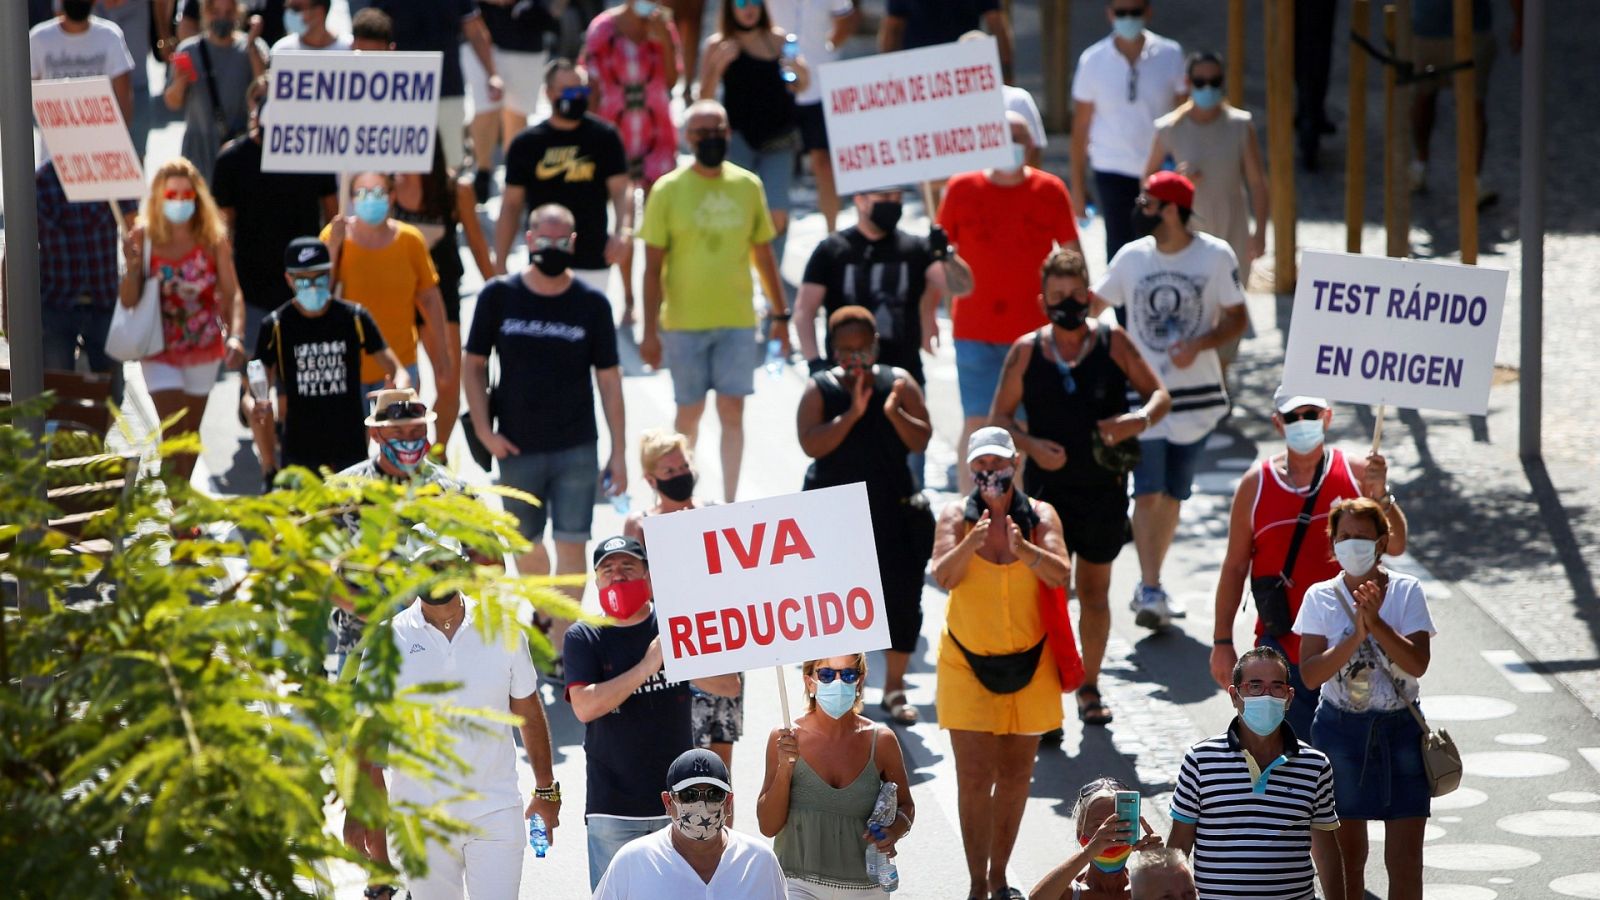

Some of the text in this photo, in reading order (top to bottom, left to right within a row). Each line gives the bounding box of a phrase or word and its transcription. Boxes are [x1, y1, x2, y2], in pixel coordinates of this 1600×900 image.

[275, 69, 435, 101] BENIDORM
[908, 75, 926, 102] DE
[928, 69, 954, 99] LOS
[955, 63, 996, 95] ERTES
[271, 124, 430, 155] DESTINO SEGURO
[836, 121, 1006, 171] HASTA EL 15 DE MARZO 2021
[1313, 279, 1488, 327] TEST RÁPIDO
[1315, 344, 1465, 388] EN ORIGEN
[703, 518, 815, 575] IVA
[668, 586, 875, 660] REDUCIDO
